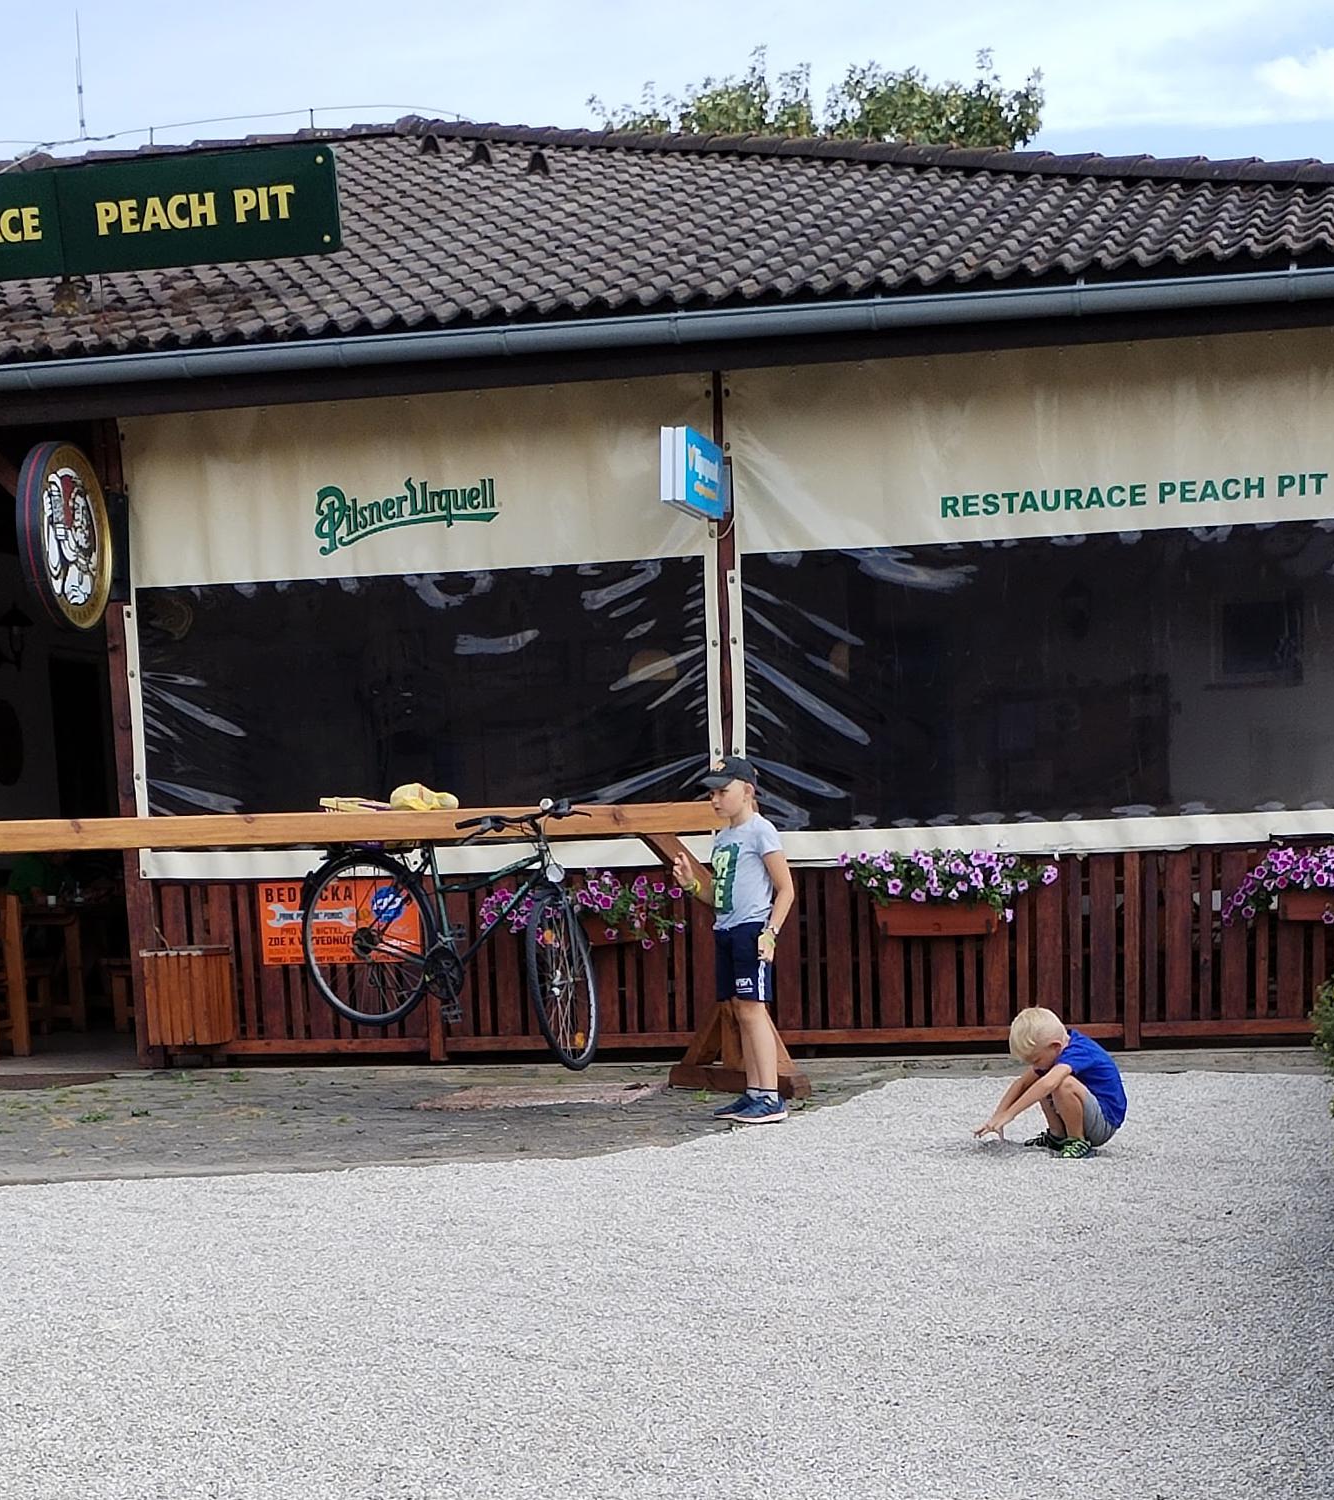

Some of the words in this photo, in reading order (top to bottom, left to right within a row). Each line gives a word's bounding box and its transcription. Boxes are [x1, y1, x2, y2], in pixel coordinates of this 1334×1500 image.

[95, 191, 218, 236] PEACH
[233, 184, 296, 223] PIT
[315, 486, 408, 556] Pilsner
[405, 477, 496, 528] Urquell
[940, 483, 1147, 518] RESTAURACE
[1158, 476, 1265, 504] PEACH
[1277, 472, 1329, 497] PIT
[268, 936, 286, 946] ZDE
